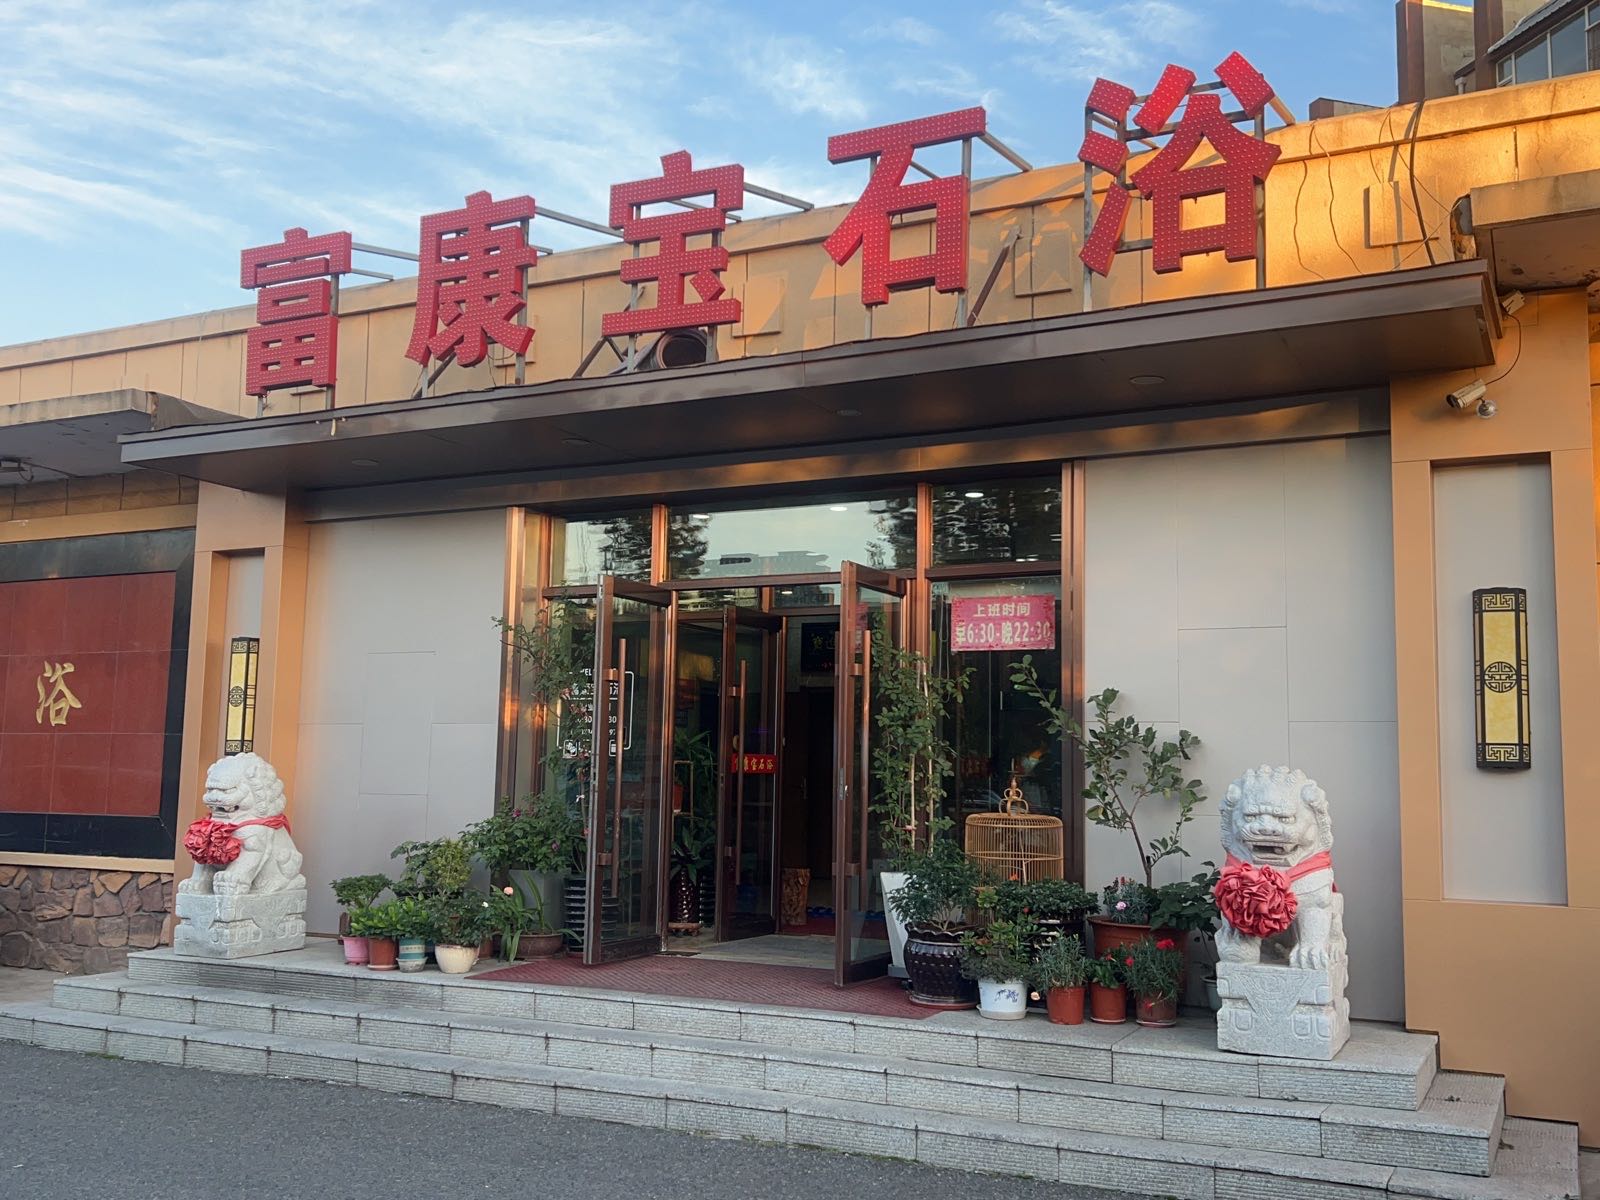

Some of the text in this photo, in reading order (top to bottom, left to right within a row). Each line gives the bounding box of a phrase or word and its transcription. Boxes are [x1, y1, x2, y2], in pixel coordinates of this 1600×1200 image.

[240, 51, 1281, 397] 富康宝石浴
[973, 602, 1030, 617] 上班时间
[36, 660, 82, 727] 浴
[735, 756, 774, 771] 康宝石浴
